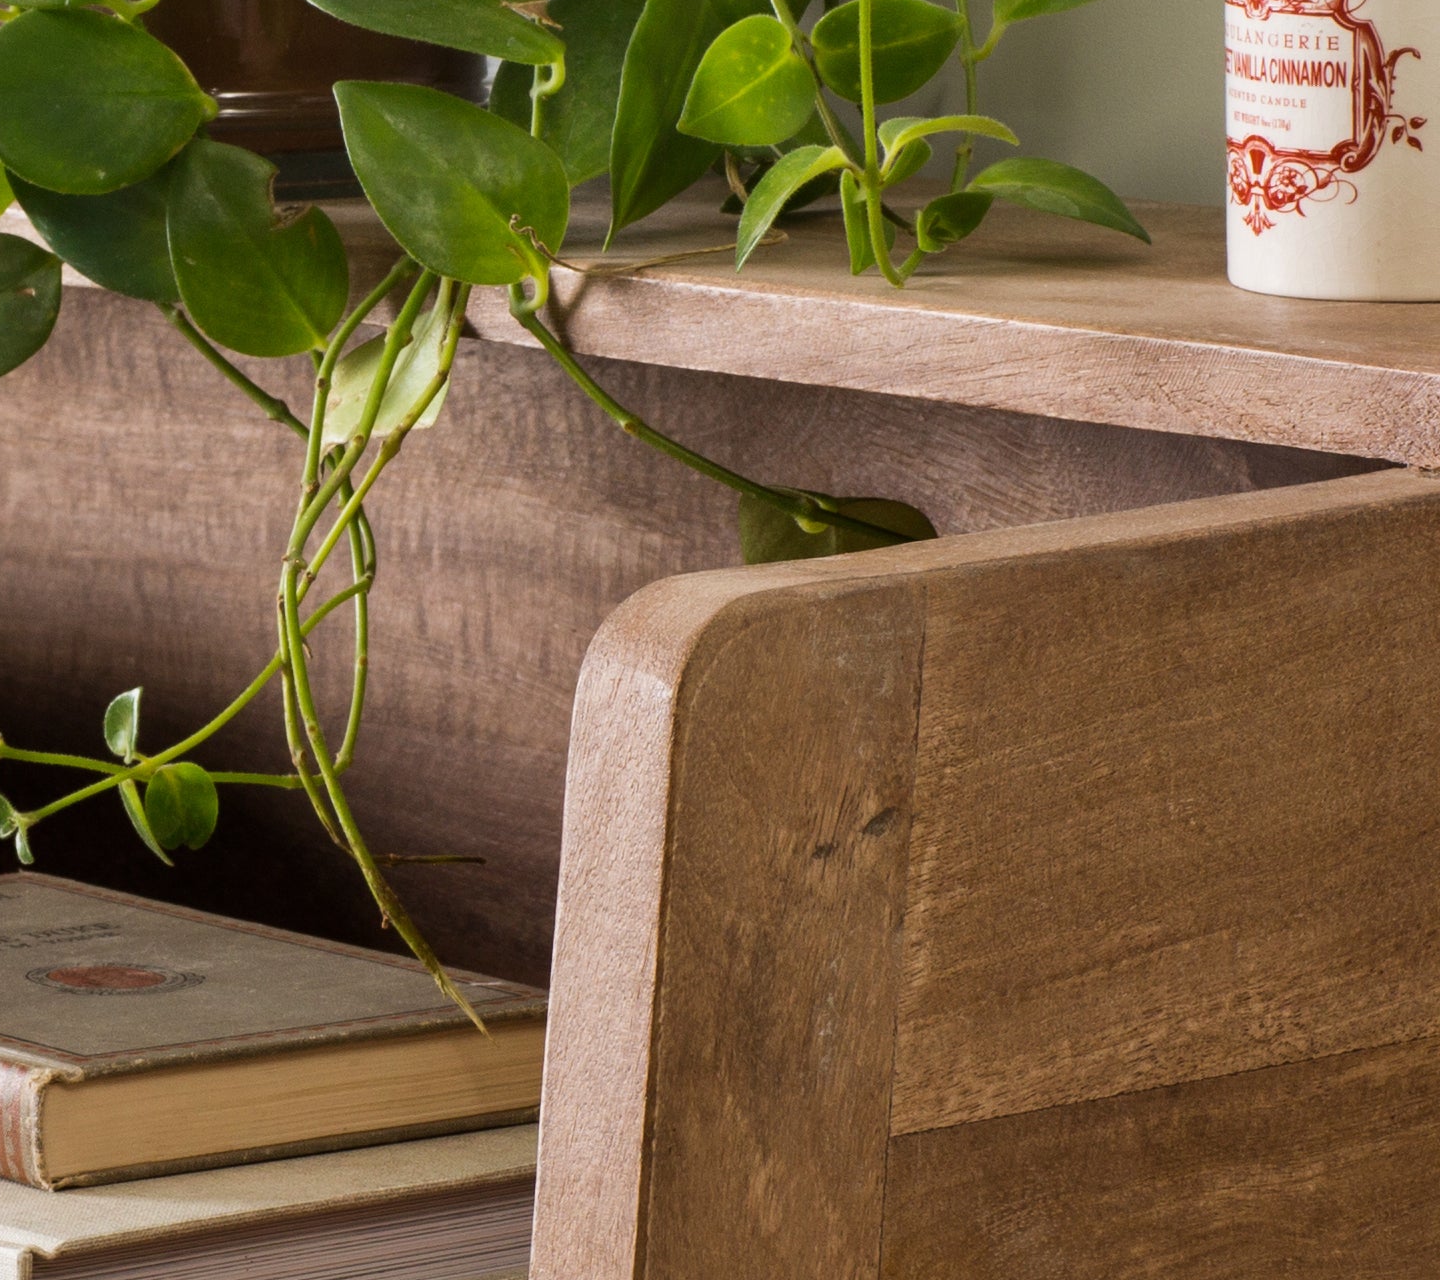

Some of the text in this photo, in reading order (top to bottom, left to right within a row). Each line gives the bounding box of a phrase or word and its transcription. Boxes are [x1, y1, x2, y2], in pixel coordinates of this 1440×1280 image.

[1234, 51, 1268, 82] VANILLA
[1269, 58, 1347, 88] CINNAMON
[1260, 95, 1307, 109] CANDLE
[22, 922, 121, 939] DUKE
